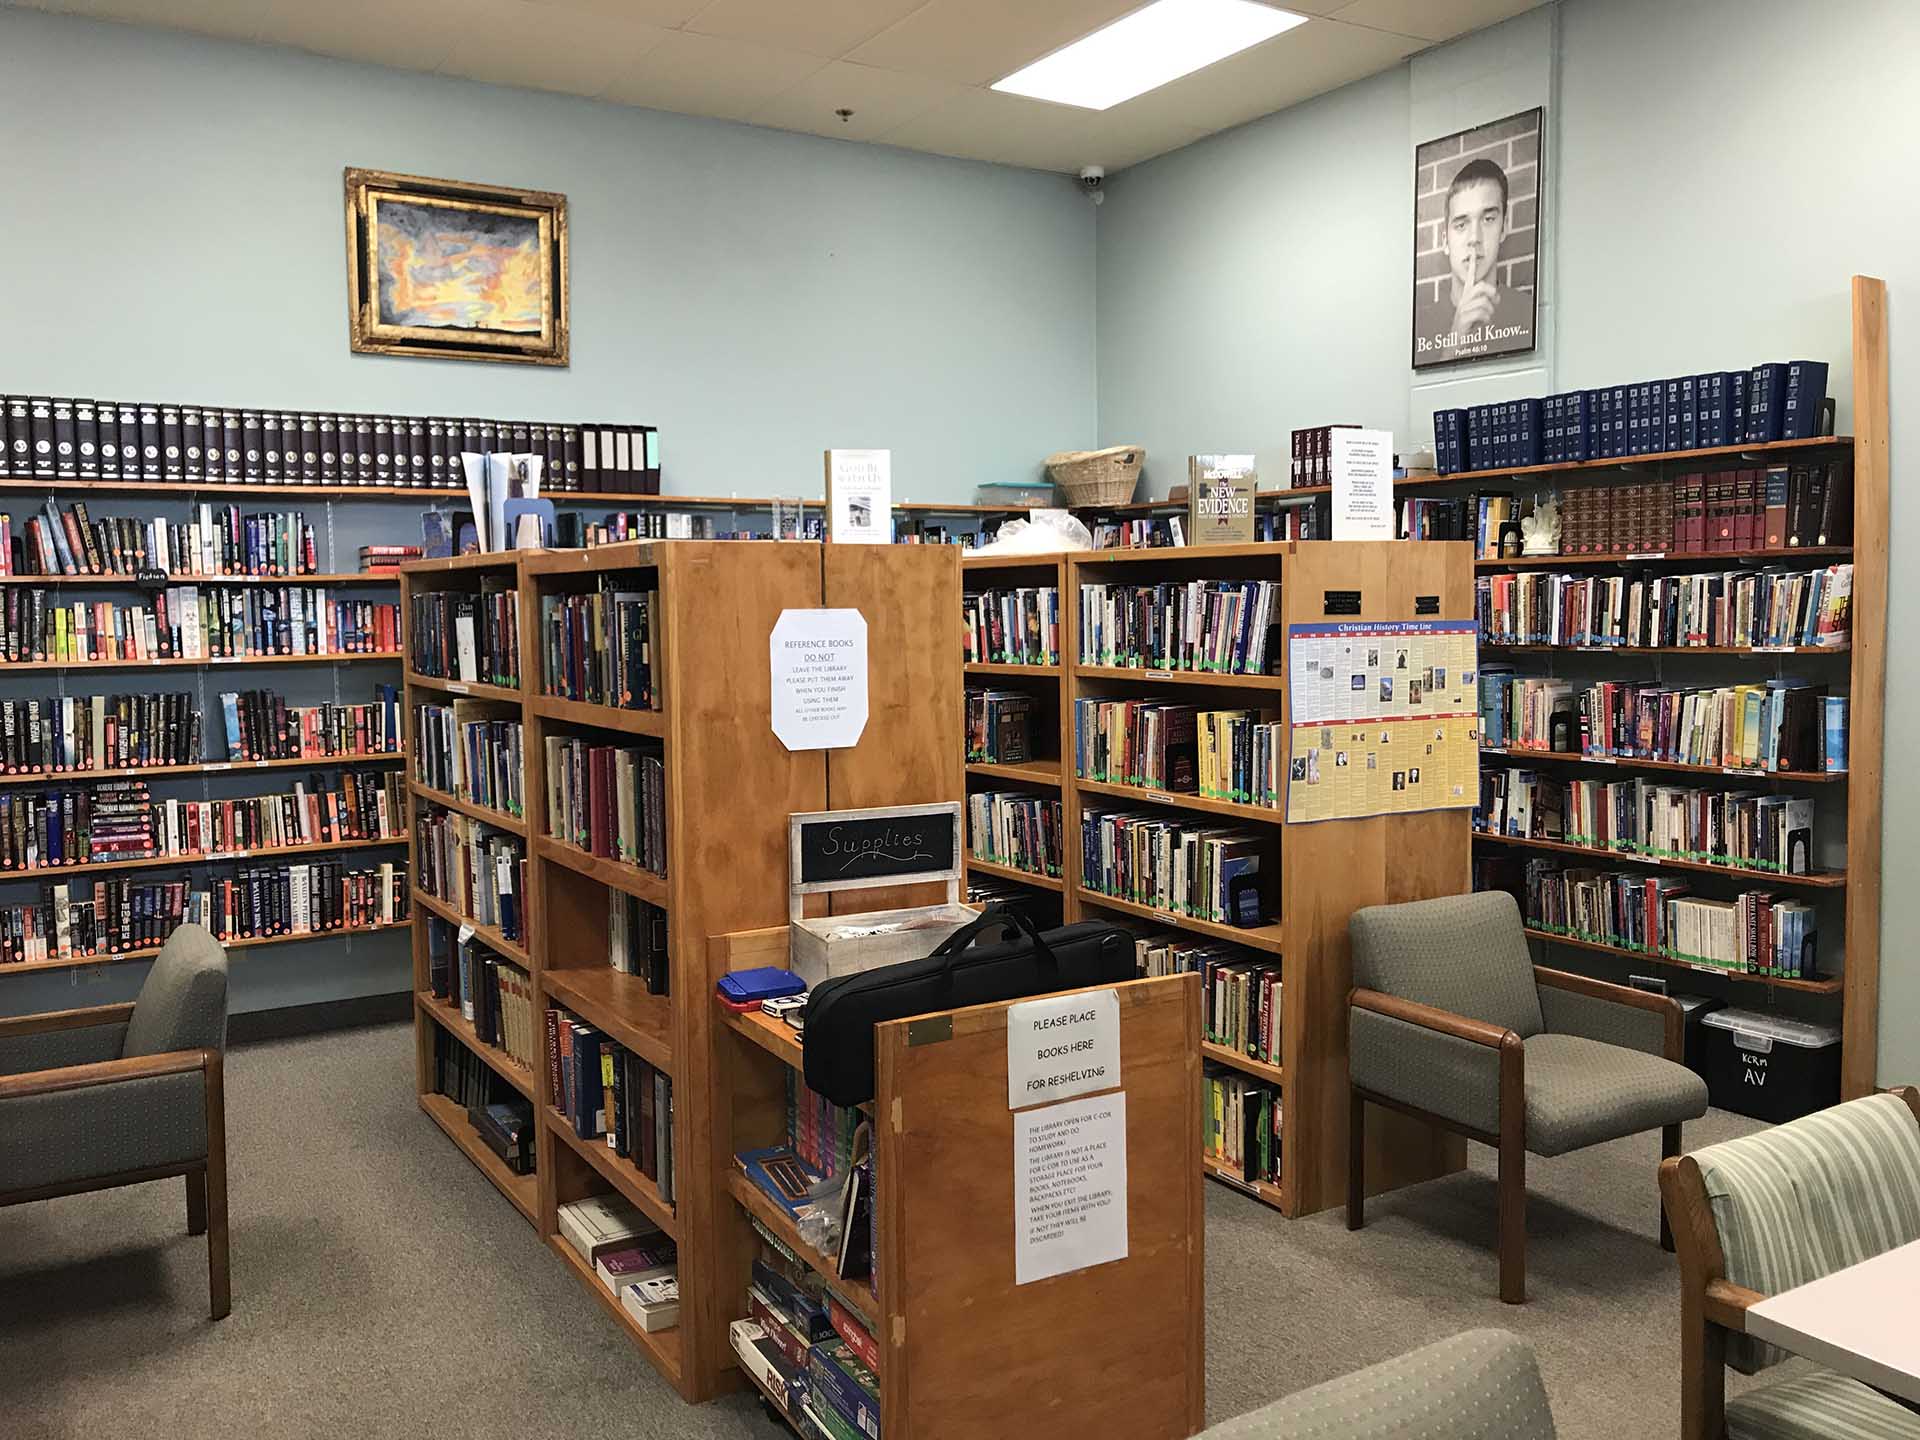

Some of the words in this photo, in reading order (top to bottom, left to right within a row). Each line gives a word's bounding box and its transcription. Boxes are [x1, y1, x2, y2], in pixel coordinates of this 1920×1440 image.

[1416, 337, 1432, 352] Be
[1434, 332, 1458, 349] Still
[1460, 328, 1482, 344] and
[1485, 324, 1529, 340] Know...
[1455, 348, 1471, 356] Psalm
[1210, 487, 1236, 498] NEW
[1198, 498, 1248, 514] EVIDENCE
[1338, 623, 1372, 632] Christian
[1374, 623, 1400, 632] History
[784, 640, 826, 649] REFERENCE
[828, 639, 854, 647] BOOKS
[804, 654, 816, 662] DO
[818, 653, 835, 662] NOT
[822, 826, 923, 859] Supplies
[1033, 1015, 1067, 1030] PLEASE
[1070, 1010, 1096, 1024] PLACE
[1038, 1045, 1068, 1060] BOOKS
[1070, 1039, 1094, 1052] HERE
[1742, 1052, 1768, 1066] KCRM
[1026, 1079, 1046, 1091] FOR
[1048, 1066, 1105, 1087] RESHELVING
[1744, 1068, 1766, 1086] AV
[1029, 1126, 1040, 1134] THE
[1041, 1122, 1062, 1132] LIBRARY
[1064, 1118, 1078, 1127] OPEN
[1038, 1132, 1056, 1142] STUDY
[1057, 1130, 1069, 1138] AND
[1041, 1152, 1063, 1163] LIBRARY
[1071, 1148, 1083, 1156] NOT
[1090, 1142, 1107, 1151] PLACE
[1029, 1166, 1041, 1175] FOR
[1056, 1169, 1074, 1179] PLACE
[1075, 1166, 1086, 1175] FOR
[1087, 1162, 1104, 1172] YOUR
[767, 1368, 788, 1410] RISK
